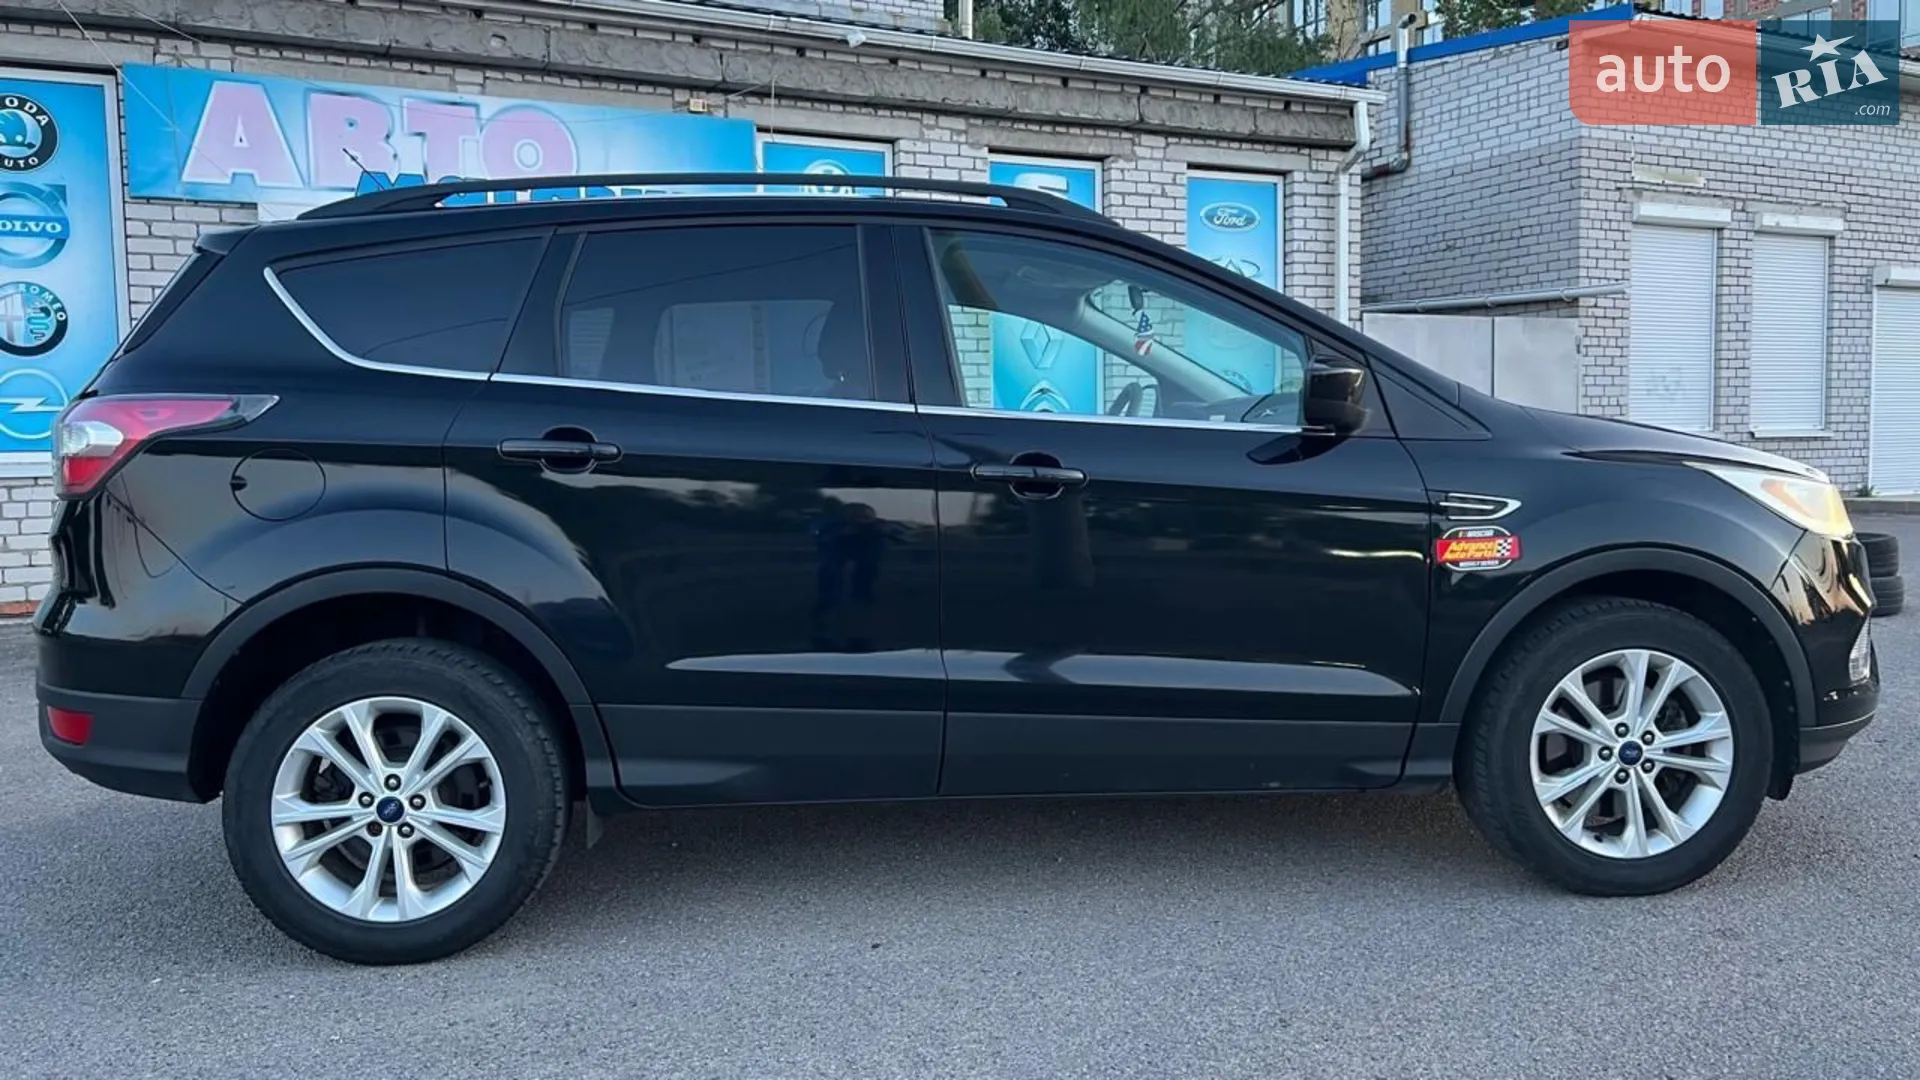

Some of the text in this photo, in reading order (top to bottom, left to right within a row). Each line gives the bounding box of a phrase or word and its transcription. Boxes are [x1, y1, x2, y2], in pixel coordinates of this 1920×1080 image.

[0, 97, 49, 126] ODA
[0, 220, 62, 233] OLVO
[1213, 208, 1247, 226] Ford
[19, 283, 67, 321] ROMEO
